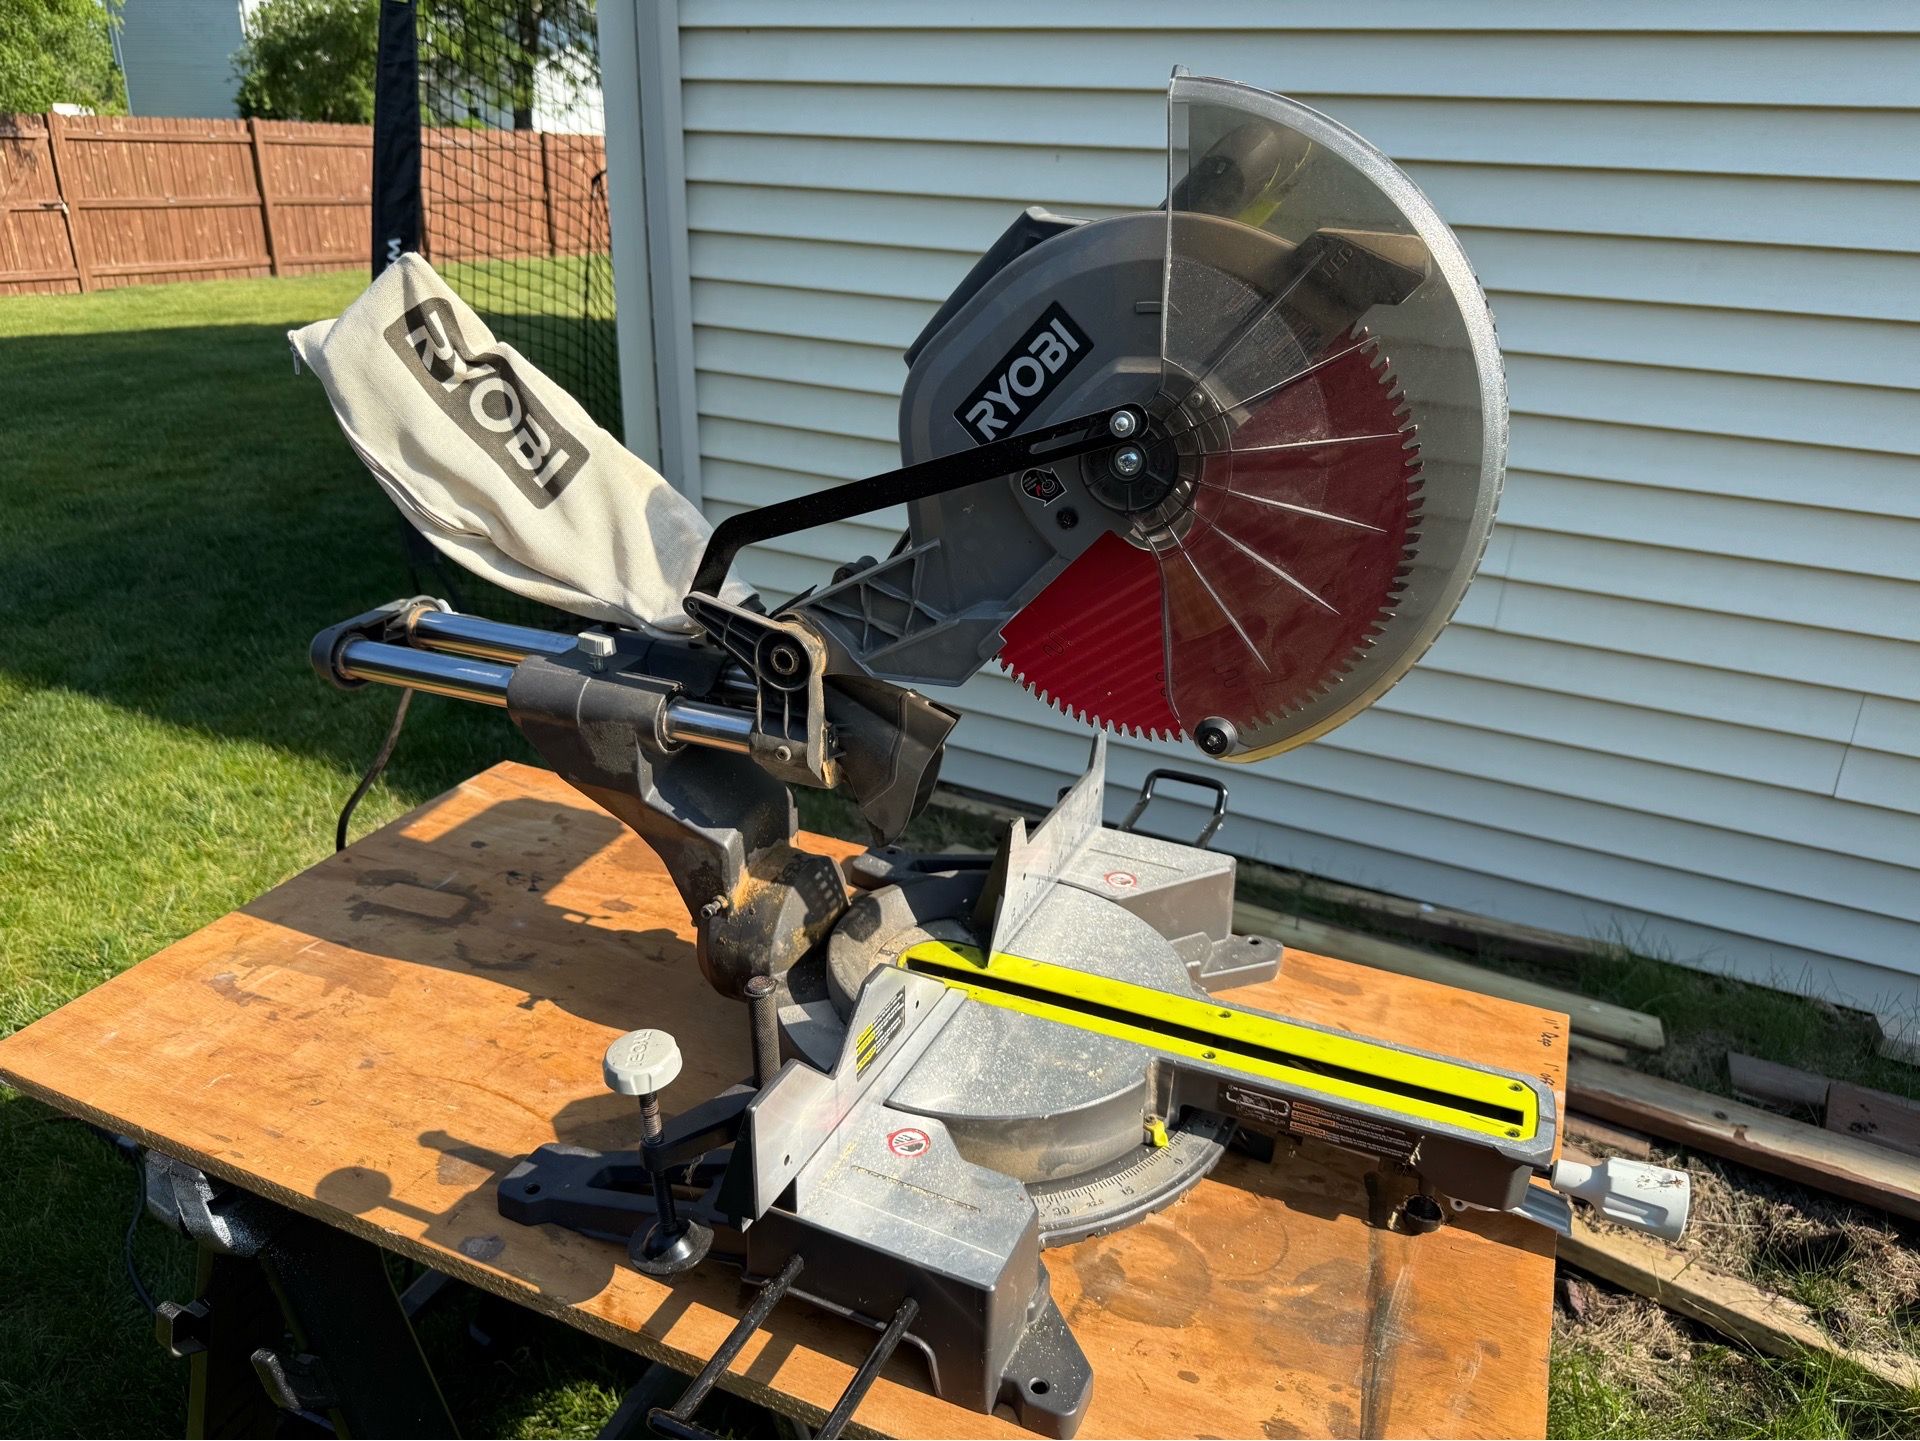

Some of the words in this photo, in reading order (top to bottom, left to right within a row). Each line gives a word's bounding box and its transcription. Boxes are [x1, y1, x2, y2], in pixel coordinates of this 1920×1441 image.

[405, 310, 570, 489] RYOBI
[965, 318, 1080, 442] RYOBI
[1052, 1206, 1070, 1217] 30
